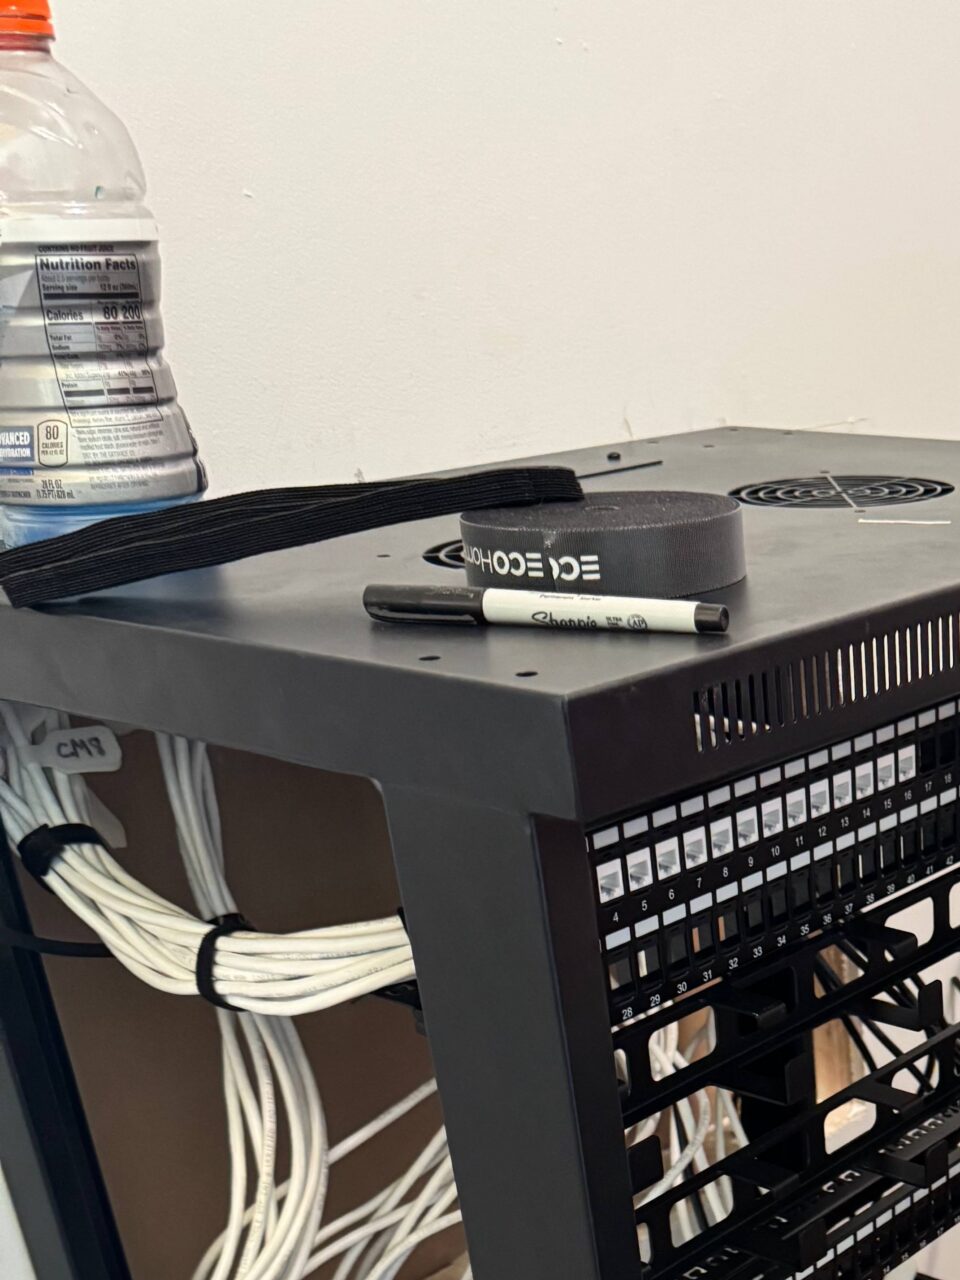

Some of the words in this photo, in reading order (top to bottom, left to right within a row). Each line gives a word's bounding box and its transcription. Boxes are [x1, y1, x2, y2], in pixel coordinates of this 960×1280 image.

[39, 258, 101, 271] Nutrition
[105, 257, 136, 270] Facts
[46, 309, 84, 320] Calories
[103, 305, 118, 320] 80
[121, 305, 141, 320] 200
[45, 424, 59, 440] 80
[41, 441, 64, 449] CALORIES
[612, 912, 619, 923] 4
[641, 900, 648, 911] 5
[668, 889, 675, 900] 6
[696, 877, 702, 888] 7
[722, 867, 729, 878] 8
[748, 857, 754, 867] 9
[771, 846, 780, 856] 10
[795, 836, 804, 847] 11
[817, 826, 827, 837] 12
[840, 817, 849, 828] 13
[862, 808, 871, 818] 14
[884, 799, 892, 809] 15
[904, 791, 912, 801] 16
[924, 782, 932, 792] 17
[944, 774, 952, 784] 18
[622, 1007, 633, 1020] 28
[650, 994, 661, 1007] 29
[677, 982, 688, 994] 30
[702, 969, 713, 982] 31
[728, 958, 739, 970] 32
[753, 946, 763, 958] 33
[776, 935, 787, 947] 34
[800, 924, 810, 936] 35
[822, 913, 832, 926] 36
[844, 903, 854, 915] 37
[866, 893, 875, 905] 38
[887, 883, 896, 895] 39
[907, 874, 915, 885] 40
[926, 865, 934, 875] 41
[946, 856, 954, 866] 42
